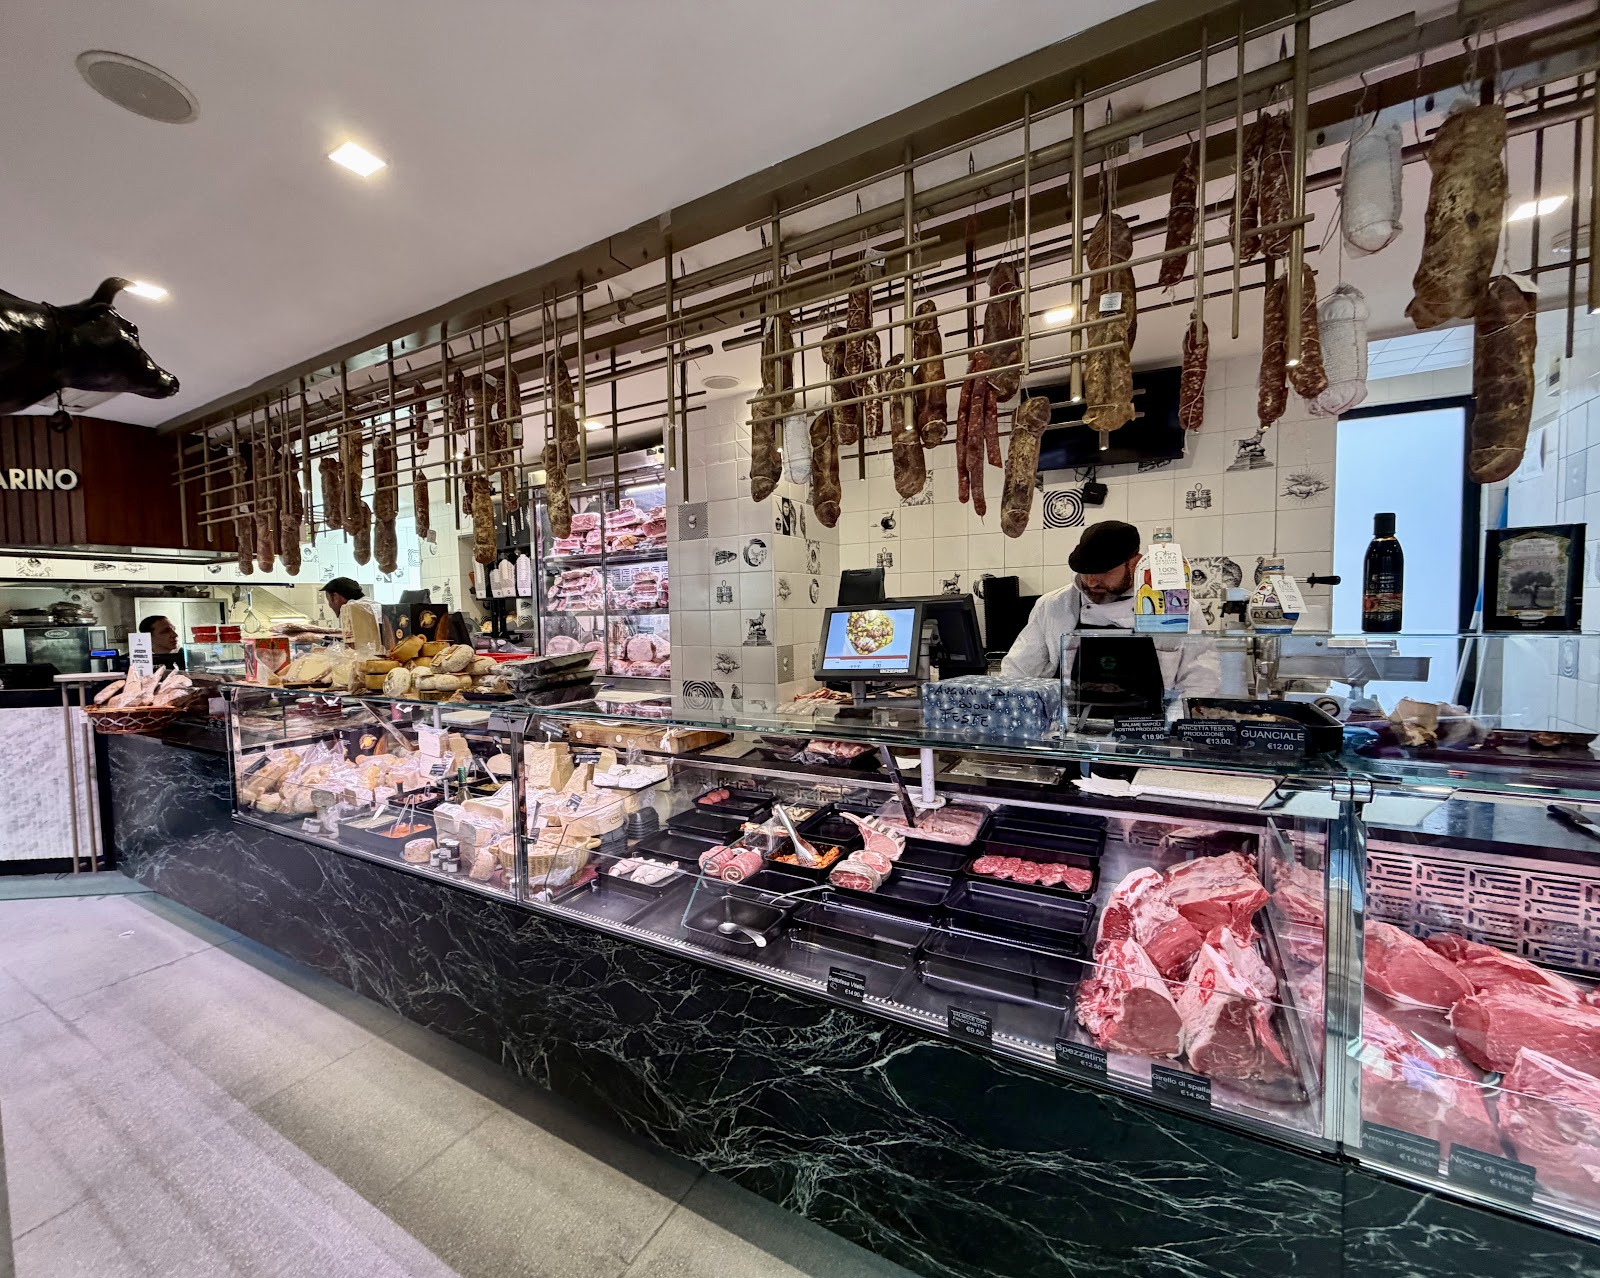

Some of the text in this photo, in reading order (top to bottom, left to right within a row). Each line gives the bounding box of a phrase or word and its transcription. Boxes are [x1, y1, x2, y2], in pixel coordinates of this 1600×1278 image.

[934, 684, 977, 696] AUGURI
[1240, 729, 1305, 741] GUANCIALE
[1055, 1043, 1107, 1064] Spezzatino
[1151, 1073, 1177, 1085] Girello
[1187, 1083, 1211, 1094] spalla
[1362, 1132, 1395, 1147] Arrosto
[1450, 1153, 1482, 1170] Noce
[1484, 1165, 1496, 1174] di
